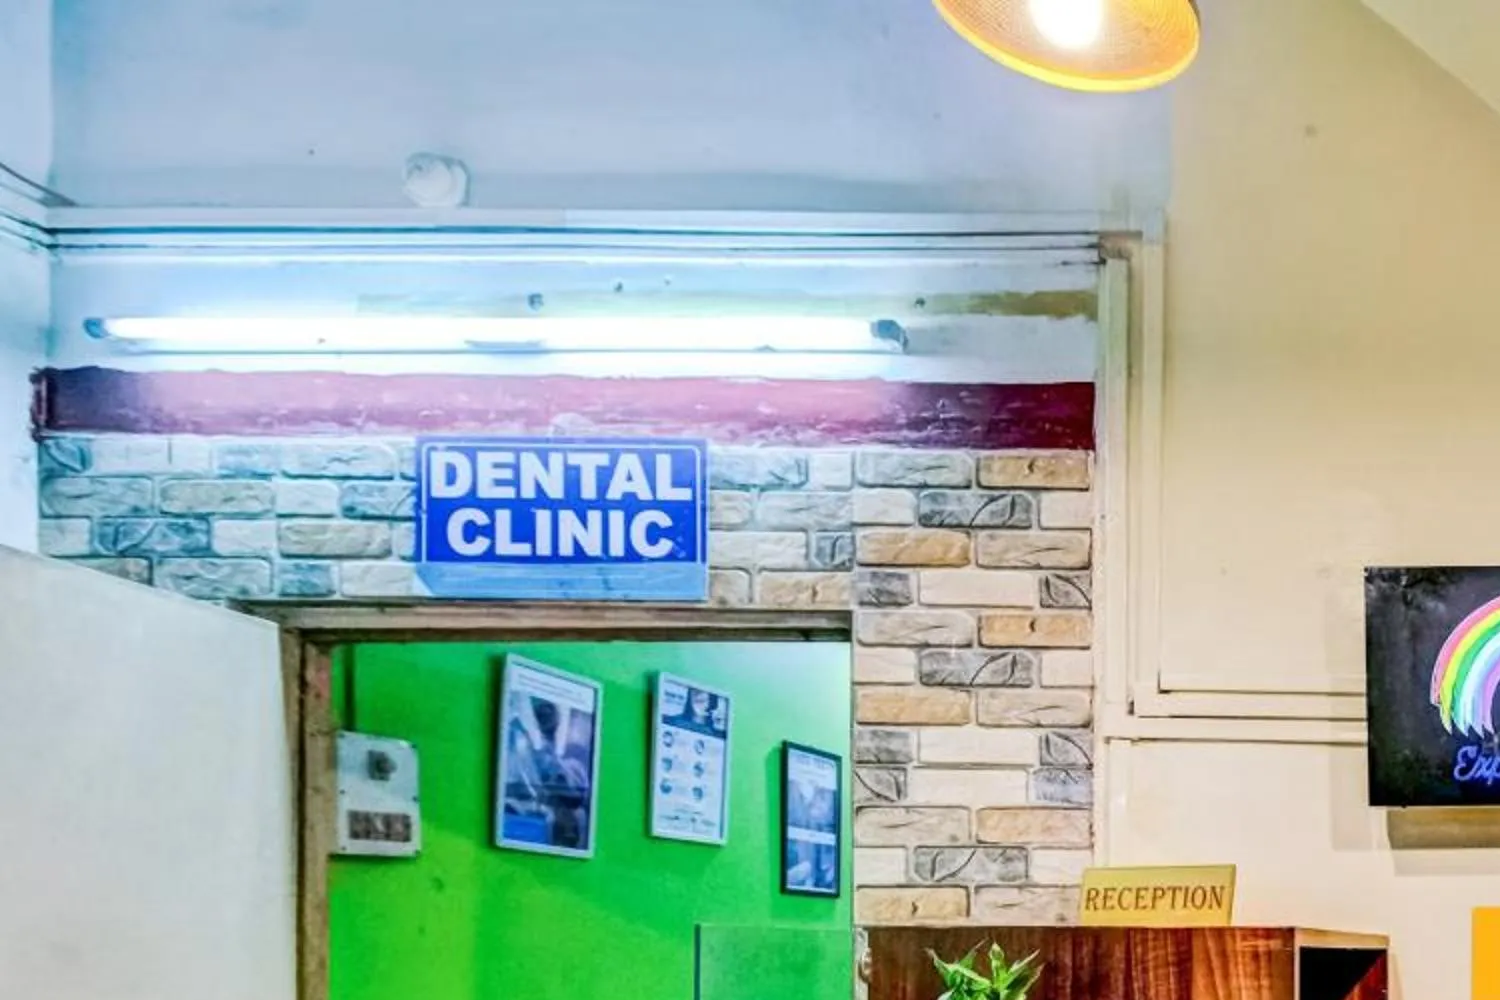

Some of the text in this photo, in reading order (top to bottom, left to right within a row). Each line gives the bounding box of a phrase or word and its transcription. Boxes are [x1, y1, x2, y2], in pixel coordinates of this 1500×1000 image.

[430, 451, 693, 502] DENTAL
[446, 508, 675, 558] CLINIC
[1084, 885, 1226, 912] RECEPTION
